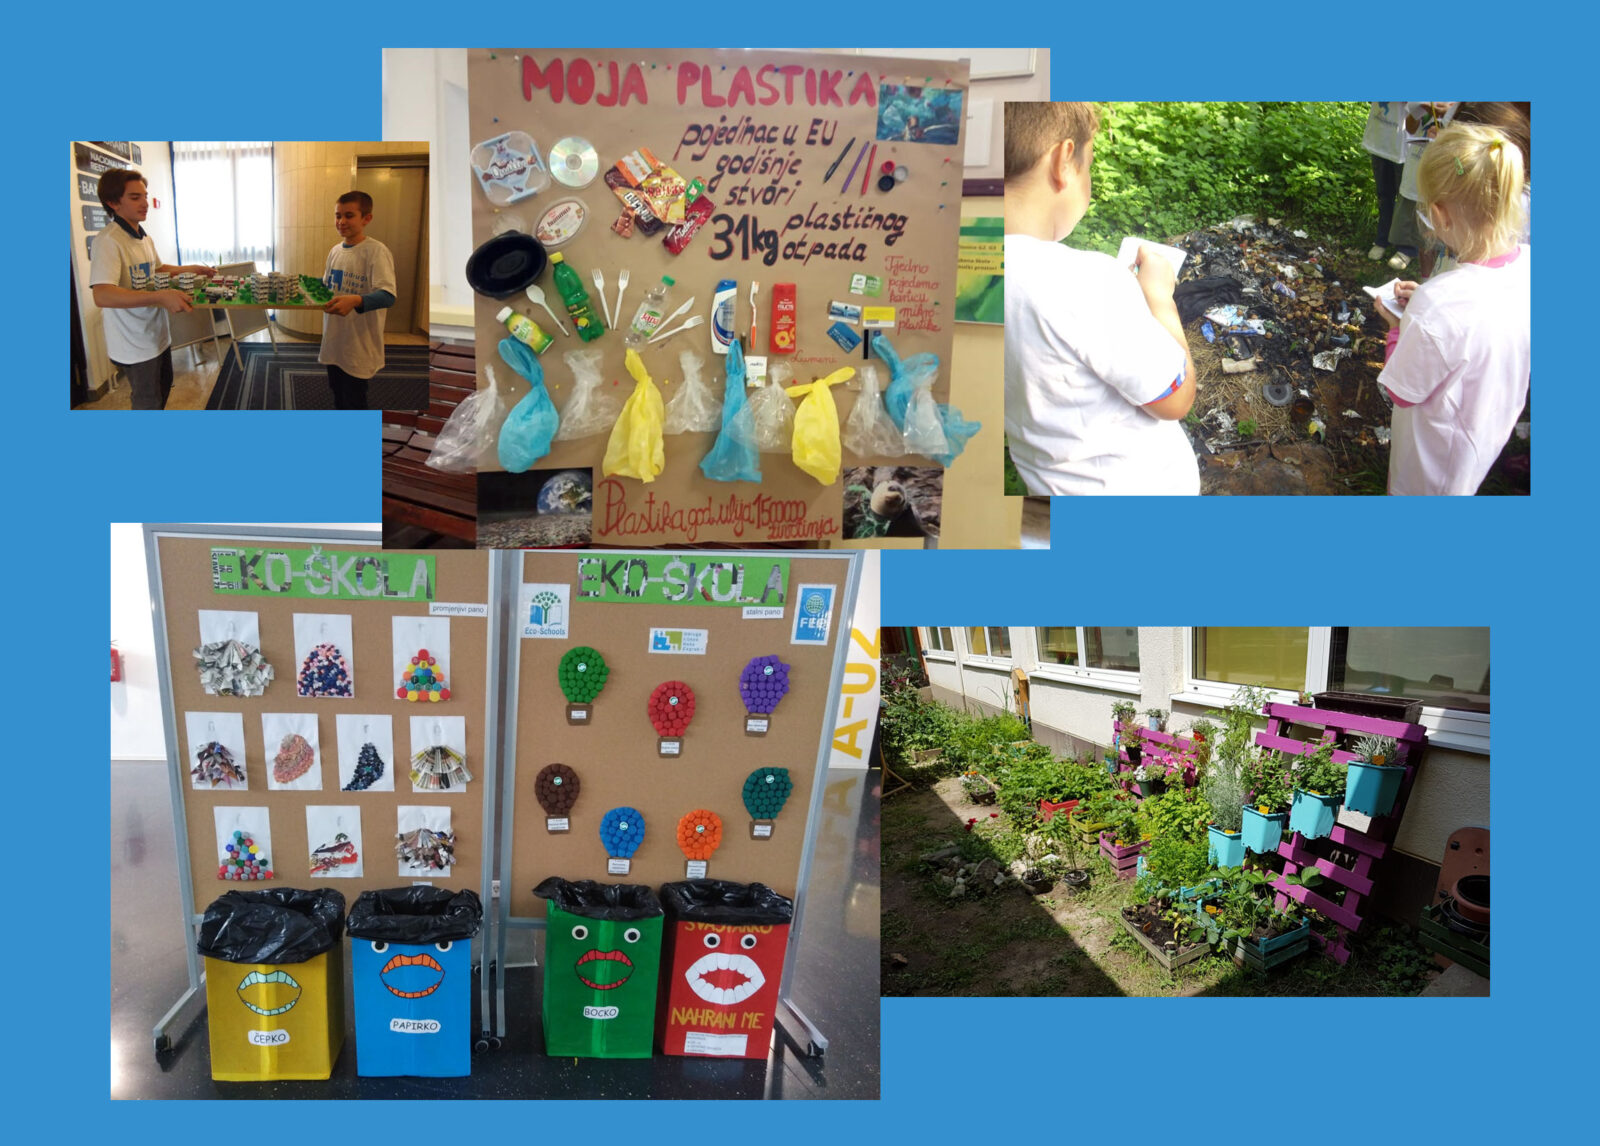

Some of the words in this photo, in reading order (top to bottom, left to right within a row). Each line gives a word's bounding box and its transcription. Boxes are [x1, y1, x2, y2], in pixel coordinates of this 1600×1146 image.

[522, 55, 648, 107] MOJA
[677, 61, 877, 108] PLASTIKA
[673, 115, 778, 161] pojedinac
[782, 124, 799, 145] u
[805, 118, 838, 145] EU
[707, 145, 803, 194] godišnje
[724, 176, 802, 206] stvori
[780, 201, 909, 246] plastičnog
[782, 233, 867, 266] otpada
[598, 479, 687, 536] Plastika
[211, 545, 433, 599] EKO-ŠKOLA
[578, 554, 784, 603] EKO-ŠKOLA
[524, 626, 566, 636] Eco-Schools
[392, 1020, 438, 1031] PAPIRKO
[584, 1007, 617, 1017] BOCKO
[671, 1007, 736, 1029] NAHRANI
[741, 1012, 765, 1029] ME
[254, 1031, 286, 1044] ČEPKO
